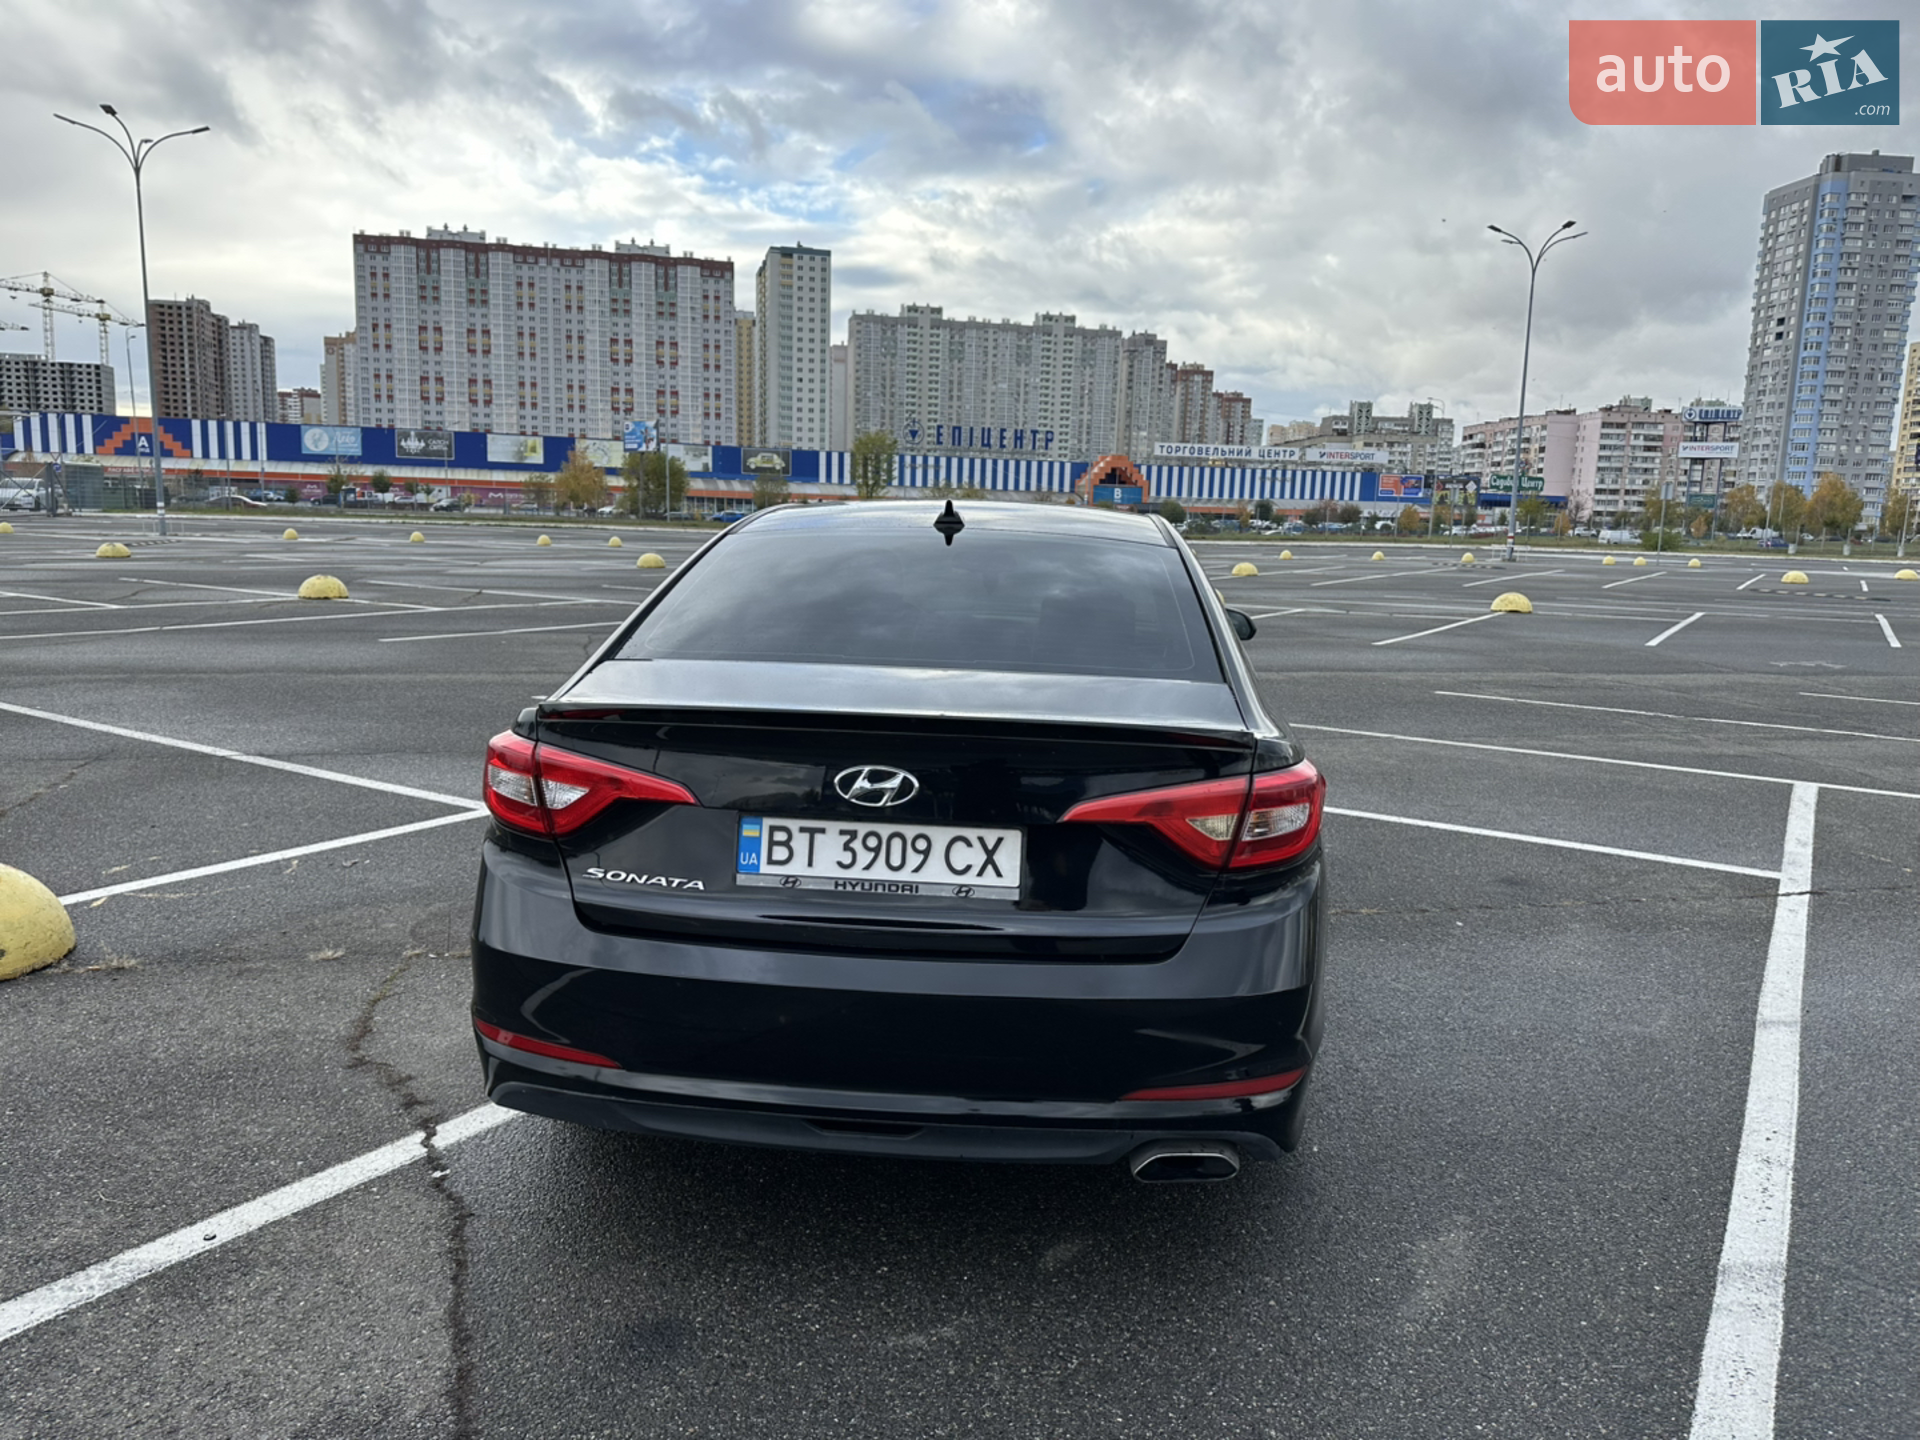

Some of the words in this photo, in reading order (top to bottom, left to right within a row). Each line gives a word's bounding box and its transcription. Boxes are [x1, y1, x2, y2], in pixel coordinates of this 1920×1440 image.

[936, 424, 1055, 451] ЕПІЦЕНТР
[1159, 444, 1252, 457] ТОРГОВЕЛЬНИЙ
[1258, 448, 1296, 459] ЦЕНТР
[1326, 451, 1376, 461] INTERSPORT
[740, 852, 758, 866] UA
[766, 824, 827, 868] BT
[836, 829, 933, 873] 3909
[944, 834, 1005, 878] CX
[582, 867, 705, 891] SONATA
[834, 879, 920, 895] HYUNDAI
